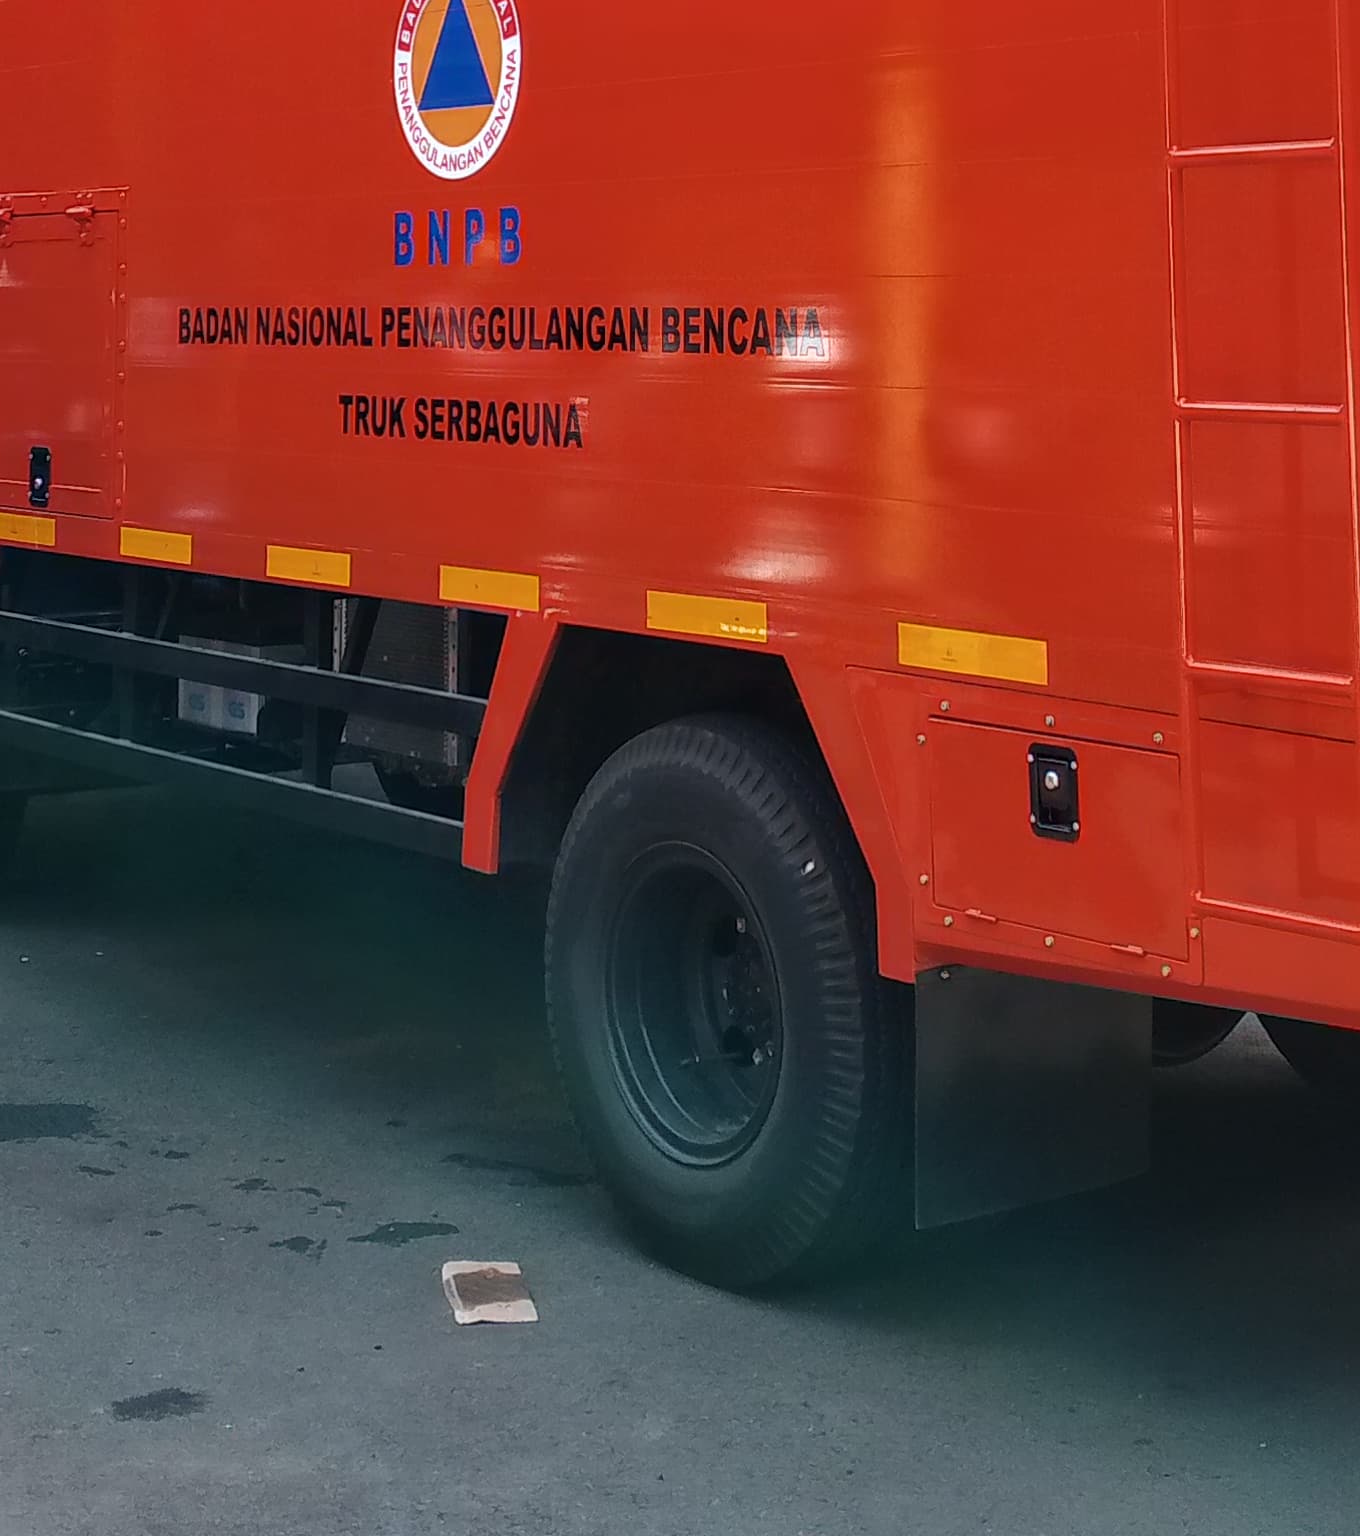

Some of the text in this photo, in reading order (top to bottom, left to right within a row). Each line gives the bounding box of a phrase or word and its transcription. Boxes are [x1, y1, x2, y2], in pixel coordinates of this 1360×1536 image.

[398, 48, 517, 172] PENANGGULANGAN BENCANA
[394, 207, 521, 266] BNPB
[177, 306, 826, 357] BADAN NASIONAL PENANGGULANGAN BENCANA
[339, 394, 584, 449] TRUK SERBAGUNA
